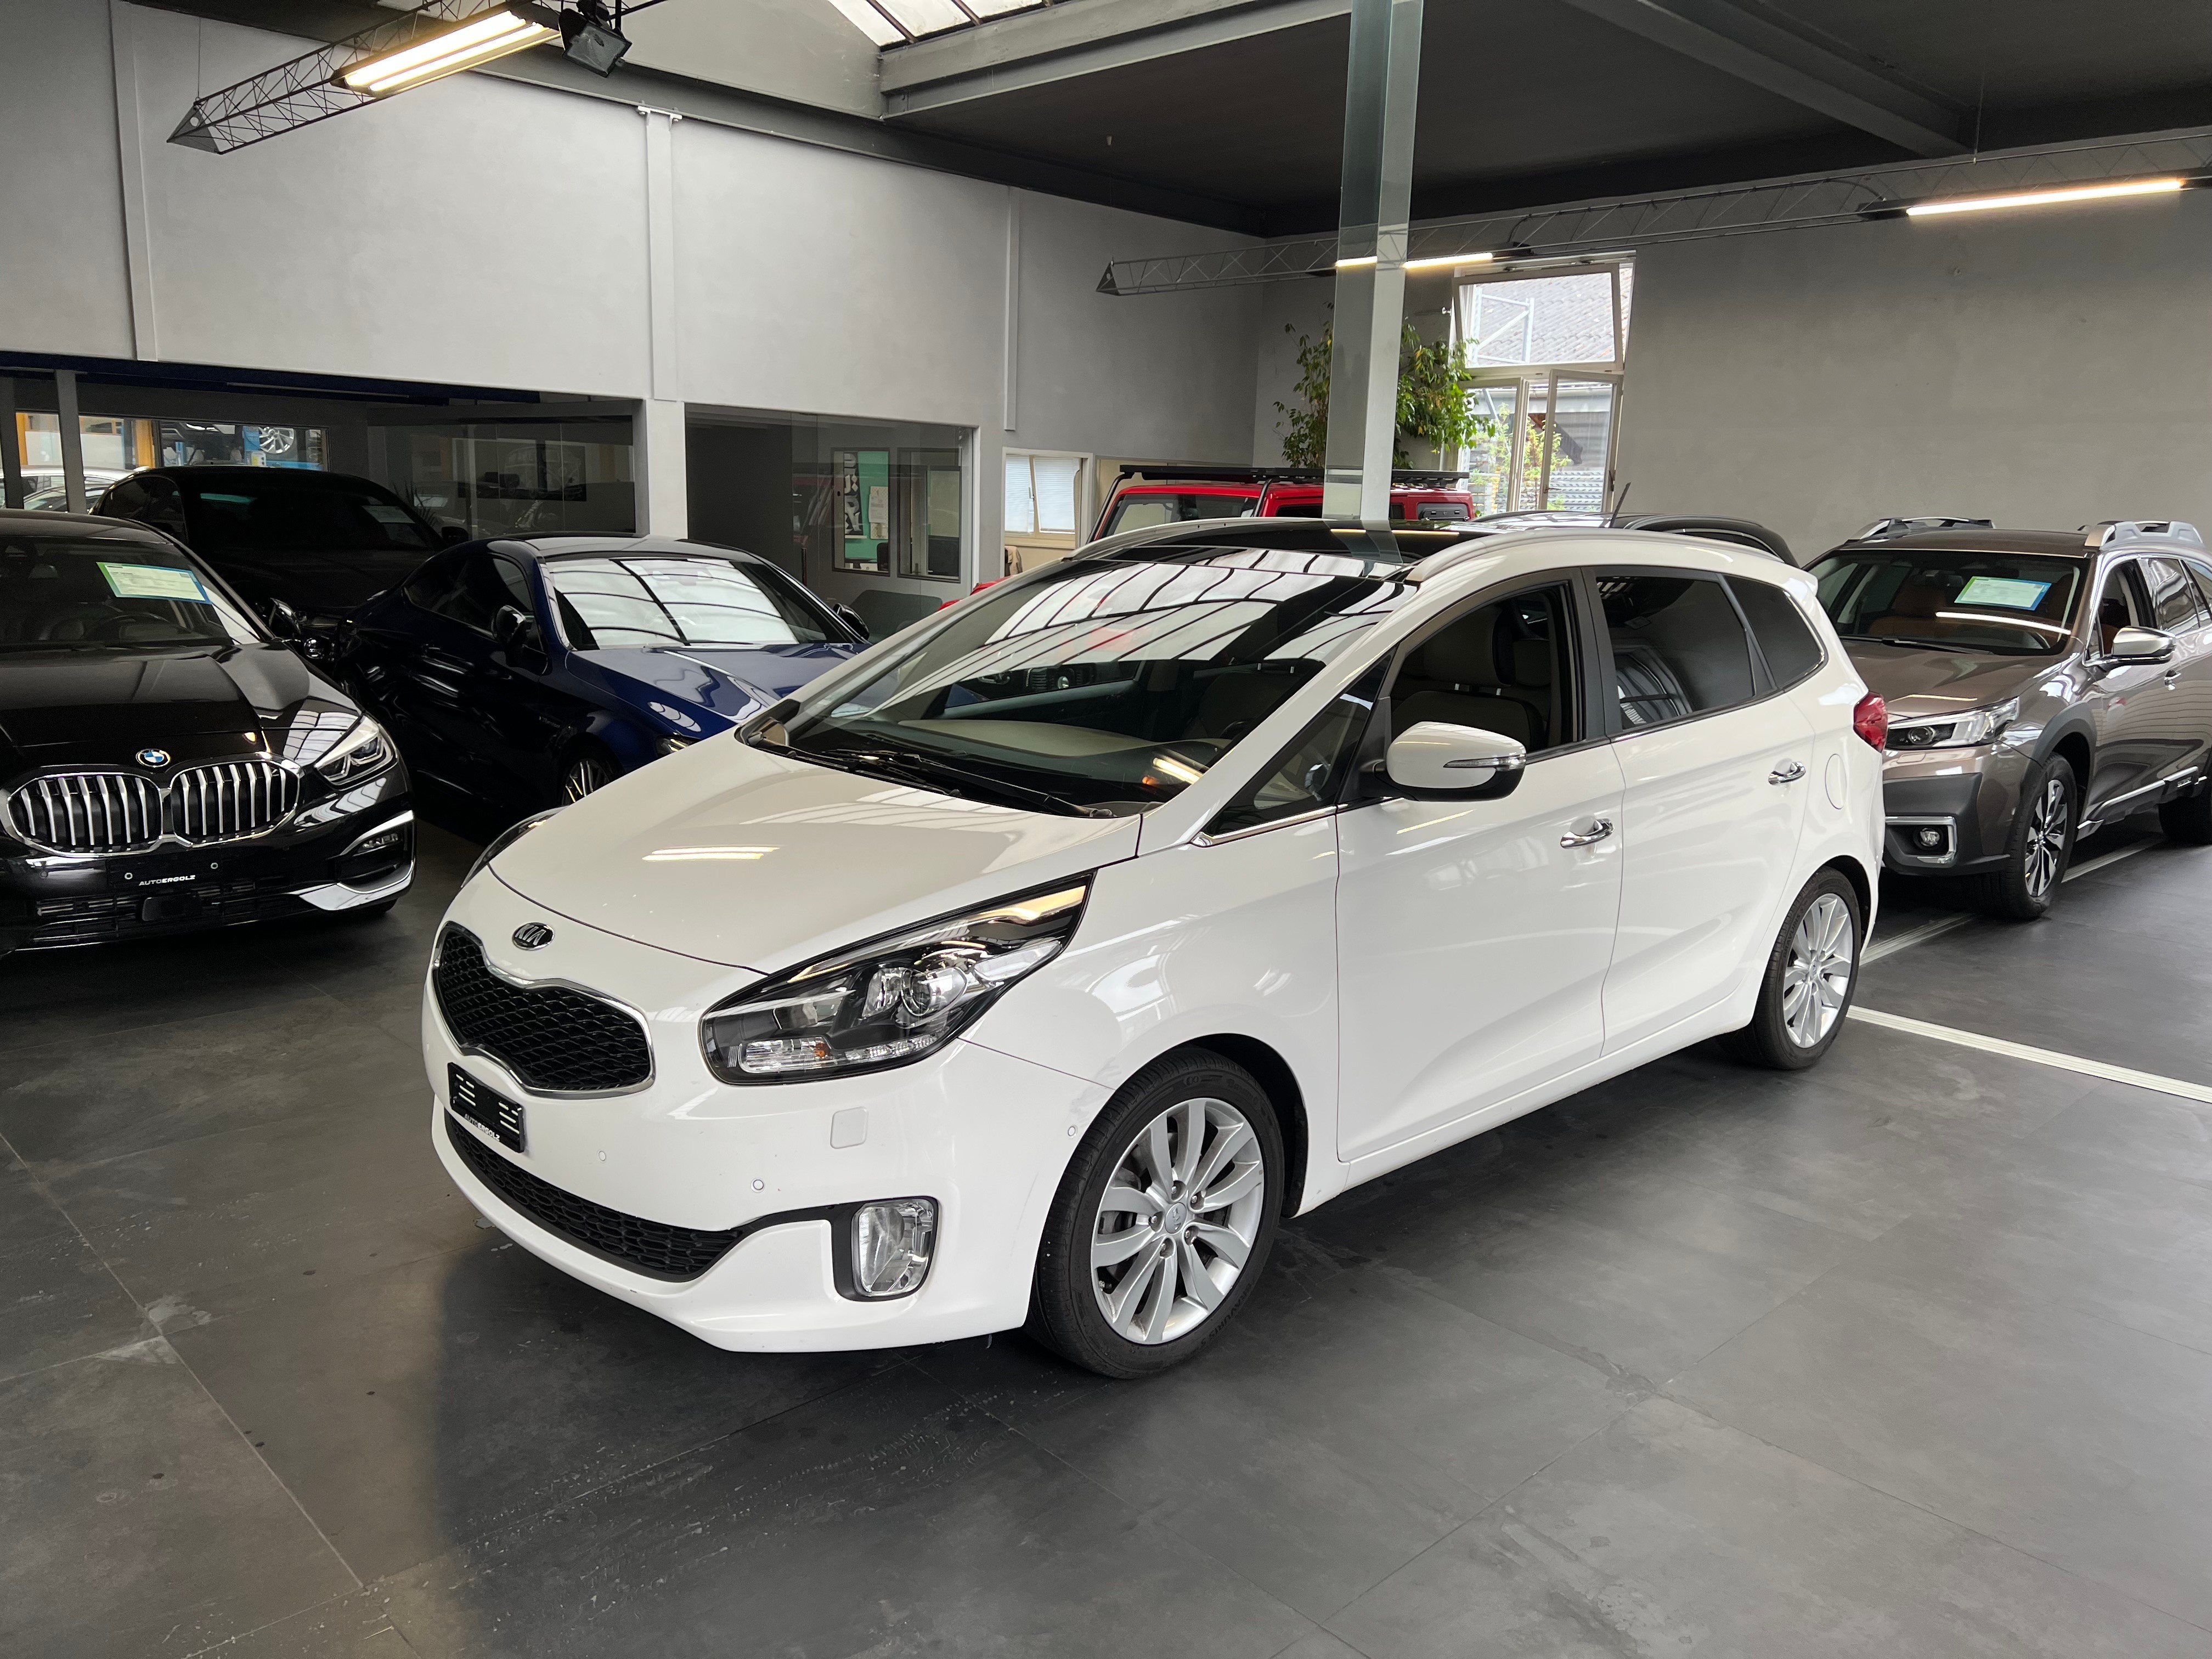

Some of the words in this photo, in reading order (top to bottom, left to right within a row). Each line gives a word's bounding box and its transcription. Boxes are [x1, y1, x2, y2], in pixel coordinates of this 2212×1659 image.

[138, 874, 196, 886] AUTOERGOLZ
[515, 924, 546, 946] KIA
[464, 1113, 500, 1142] AUTOERGOLZ
